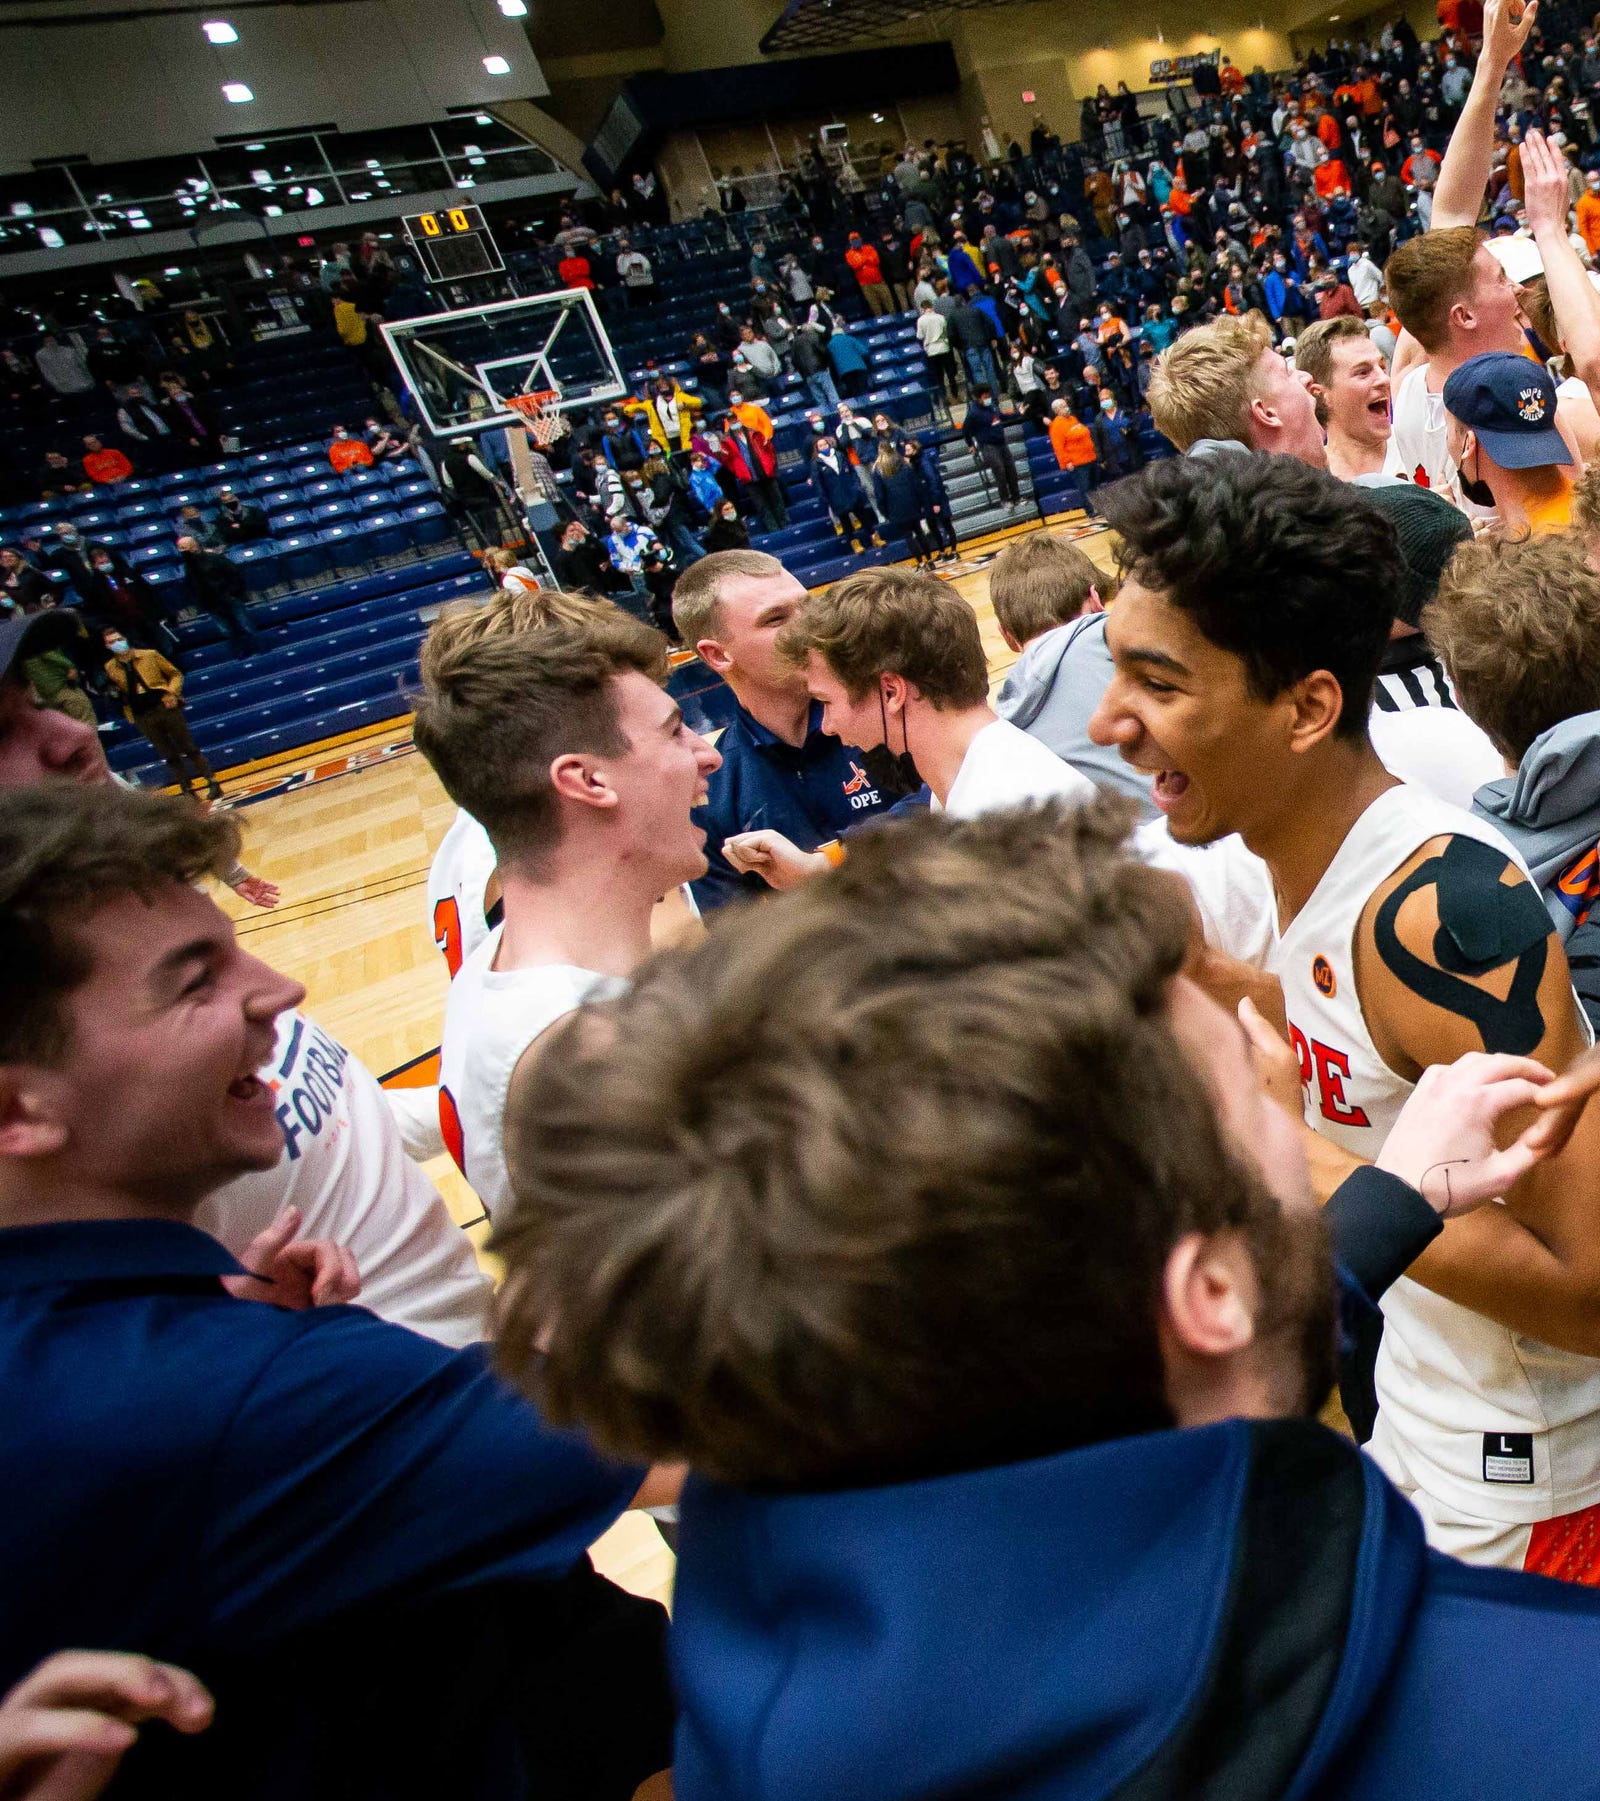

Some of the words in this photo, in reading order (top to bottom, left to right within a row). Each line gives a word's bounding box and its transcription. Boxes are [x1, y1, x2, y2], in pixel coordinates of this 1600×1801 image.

[1520, 387, 1542, 401] HOPE
[1518, 408, 1545, 421] COLLEGE
[848, 790, 882, 810] OPE
[1500, 1435, 1512, 1452] L
